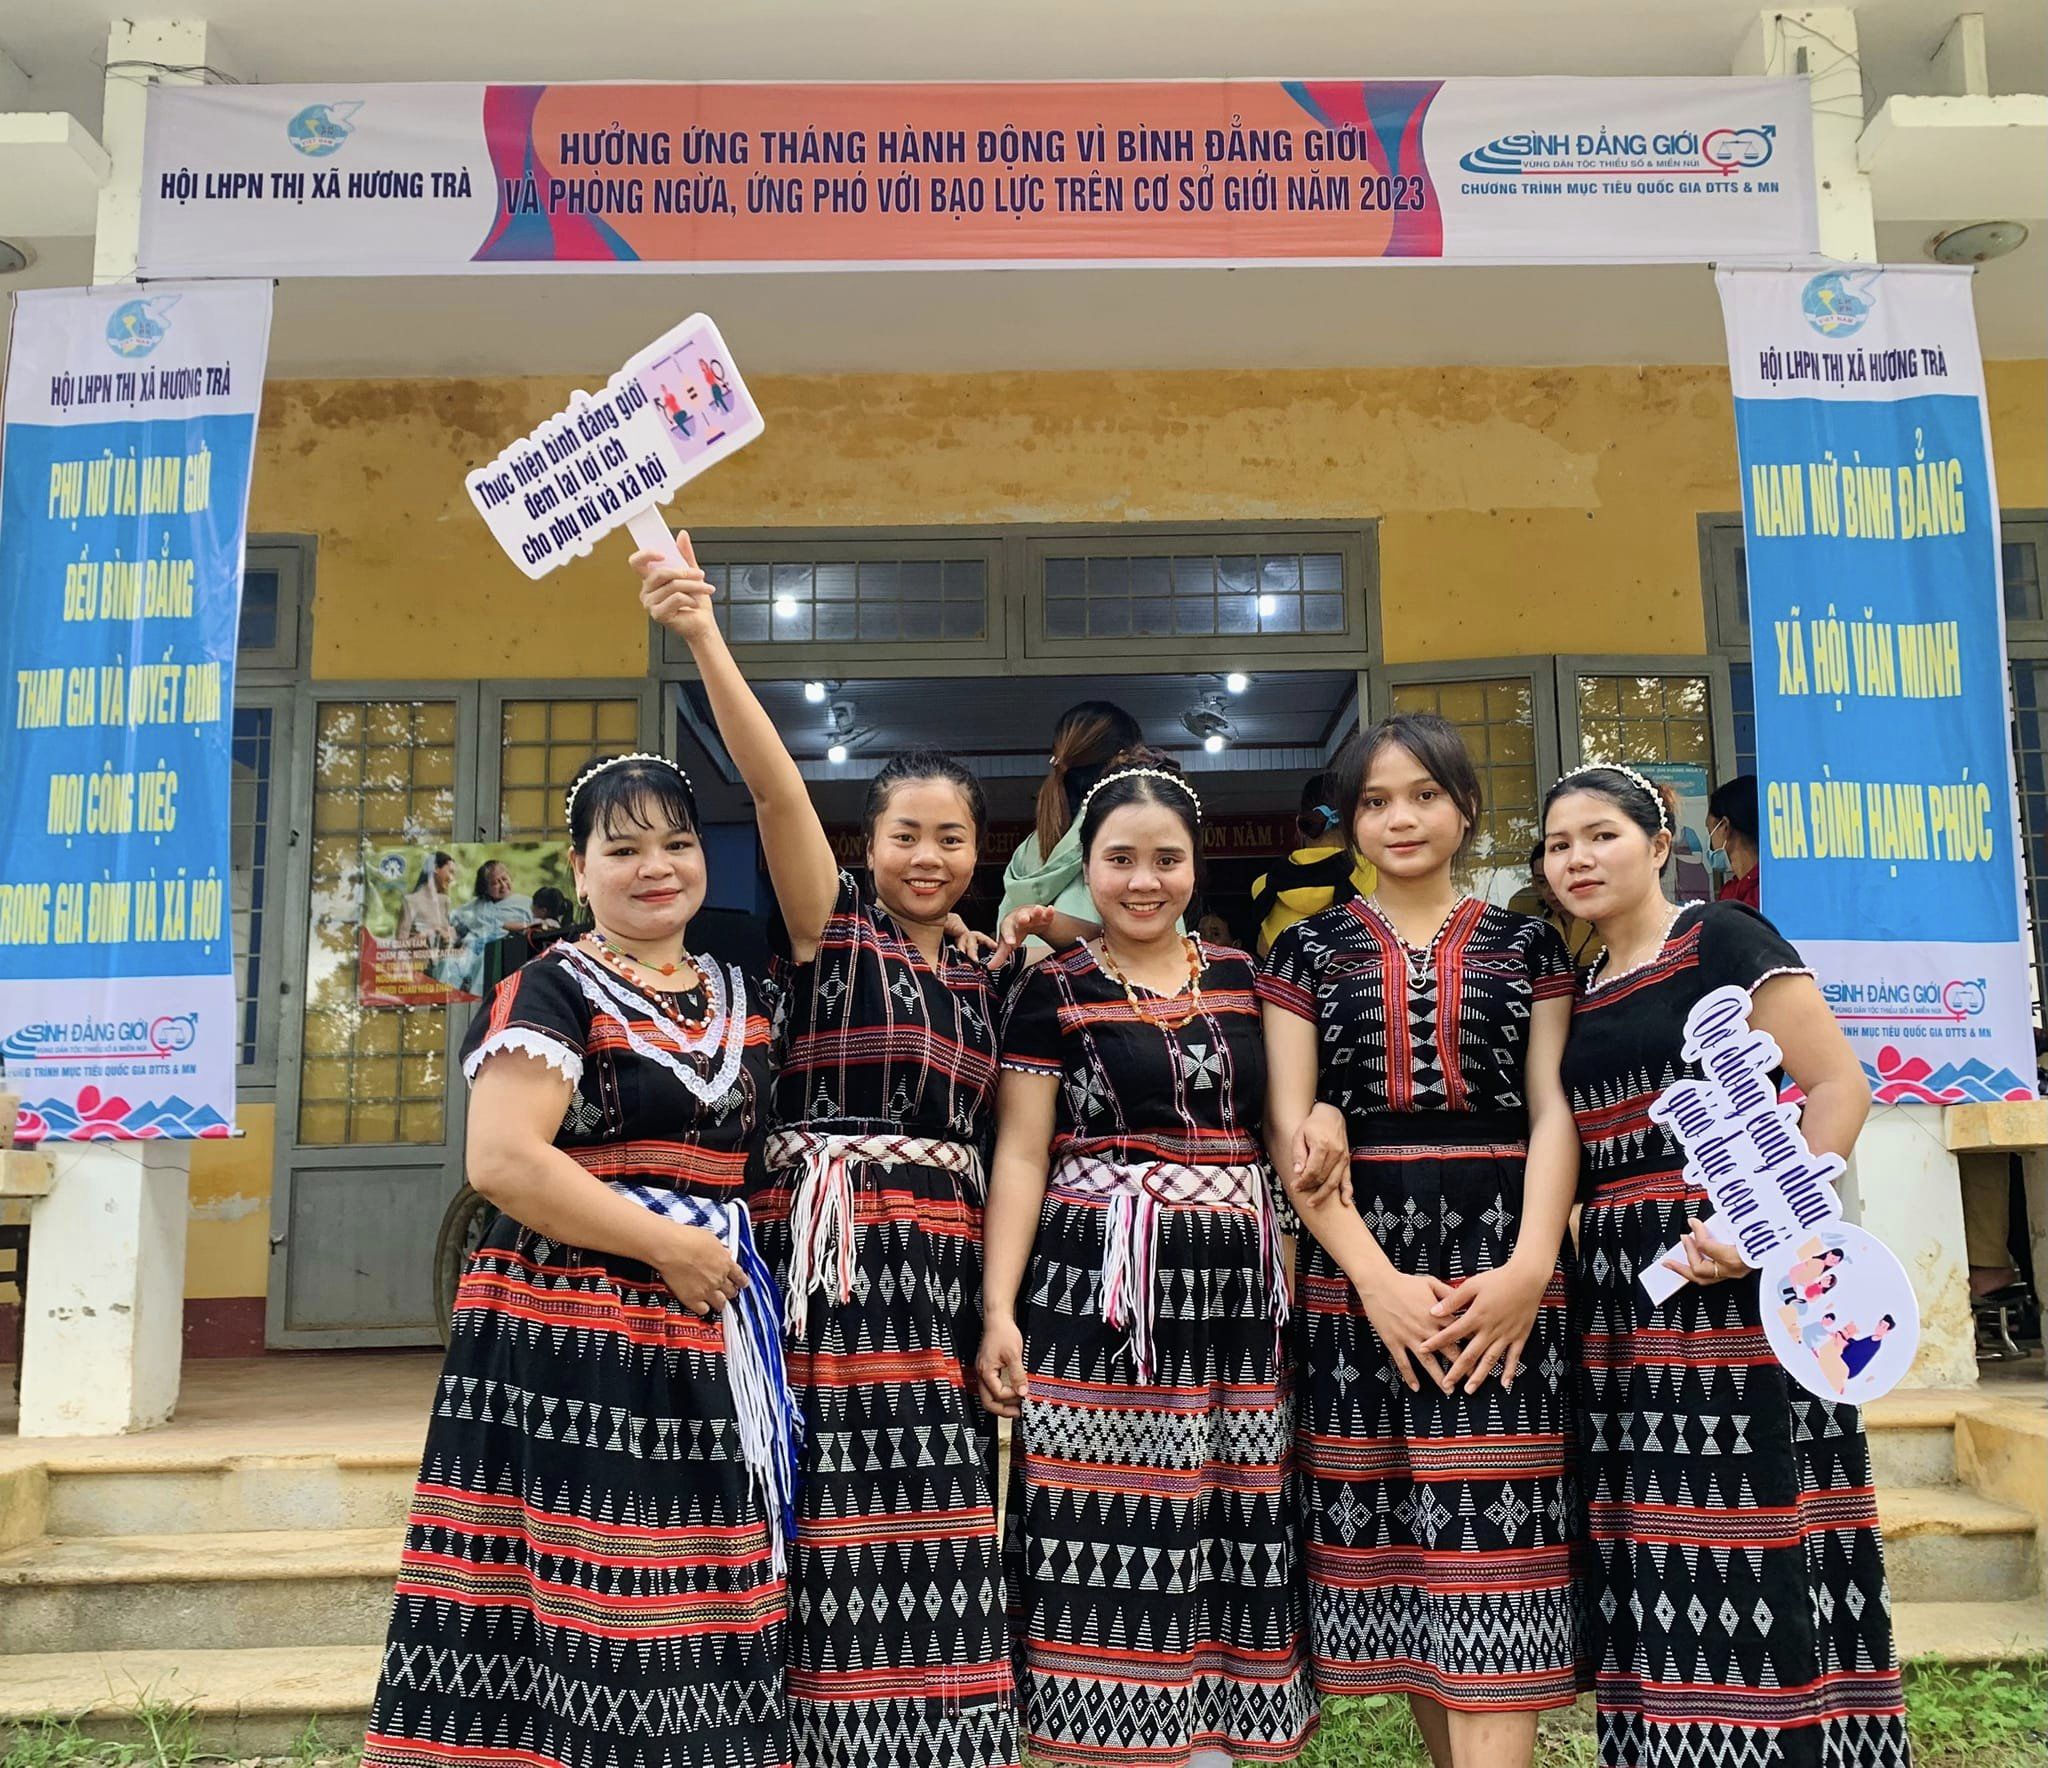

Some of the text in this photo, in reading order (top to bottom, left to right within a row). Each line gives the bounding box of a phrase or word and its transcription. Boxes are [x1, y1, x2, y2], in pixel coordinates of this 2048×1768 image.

[560, 114, 1367, 171] HƯỞNG ỨNG THÁNG HÀNH ĐỘNG VÌ BÌNH ĐẲNG GIỚI
[1503, 125, 1699, 156] BÌNH ĐẲNG GIỚI
[160, 166, 472, 205] HỘI LHPN THỊ XÃ HƯƠNG TRÀ
[505, 164, 1425, 221] VÀ PHÒNG NGỪA, ỨNG PHÓ VỚI BẠO LỰC TRÊN CƠ SỞ GIỚI NĂM 2023
[1461, 179, 1779, 196] CHƯƠNG TRÌNH MỤC TIÊU QUỐC GIA DTTS & MN
[51, 361, 231, 413] HỘI LHPN THỊ XÃ HƯƠNG TRÀ
[1760, 345, 1948, 388] HỘI LHPN THỊ XÃ HƯƠNG TRÀ
[48, 439, 212, 532] PHỤ NỮ VÀ NAM GIỚI
[475, 377, 649, 510] Thực hiện bình đẳng giới
[523, 436, 628, 521] đem lại lợi ích
[1752, 427, 1966, 540] NAM NỮ BÌNH ĐẲNG
[521, 452, 669, 565] cho phụ nữ và xã hội
[100, 548, 144, 620] BÌNH
[144, 531, 194, 619] ĐẲNG
[16, 644, 221, 737] THAM GIA VÀ QUYẾT ĐỊNH
[1774, 603, 1962, 712] XÃ HỘI VĂN MINH
[47, 758, 178, 848] MỌI CÔNG VIỆC
[1232, 820, 1273, 848] NĂM
[1767, 764, 1993, 878] GIA ĐÌNH HẠNH PHÚC
[0, 866, 223, 955] RONG GIA ĐÌNH VÀ XÃ HỘI
[25, 1015, 148, 1042] BÌNH ĐẲNG GIỚI
[1823, 977, 1941, 1003] BÌNH ĐẲNG GIỚI
[1657, 1087, 1792, 1261] giáo dục con cái
[1710, 1042, 1772, 1120] chồng
[1746, 1111, 1797, 1174] cùng
[1776, 1165, 1835, 1229] nhau
